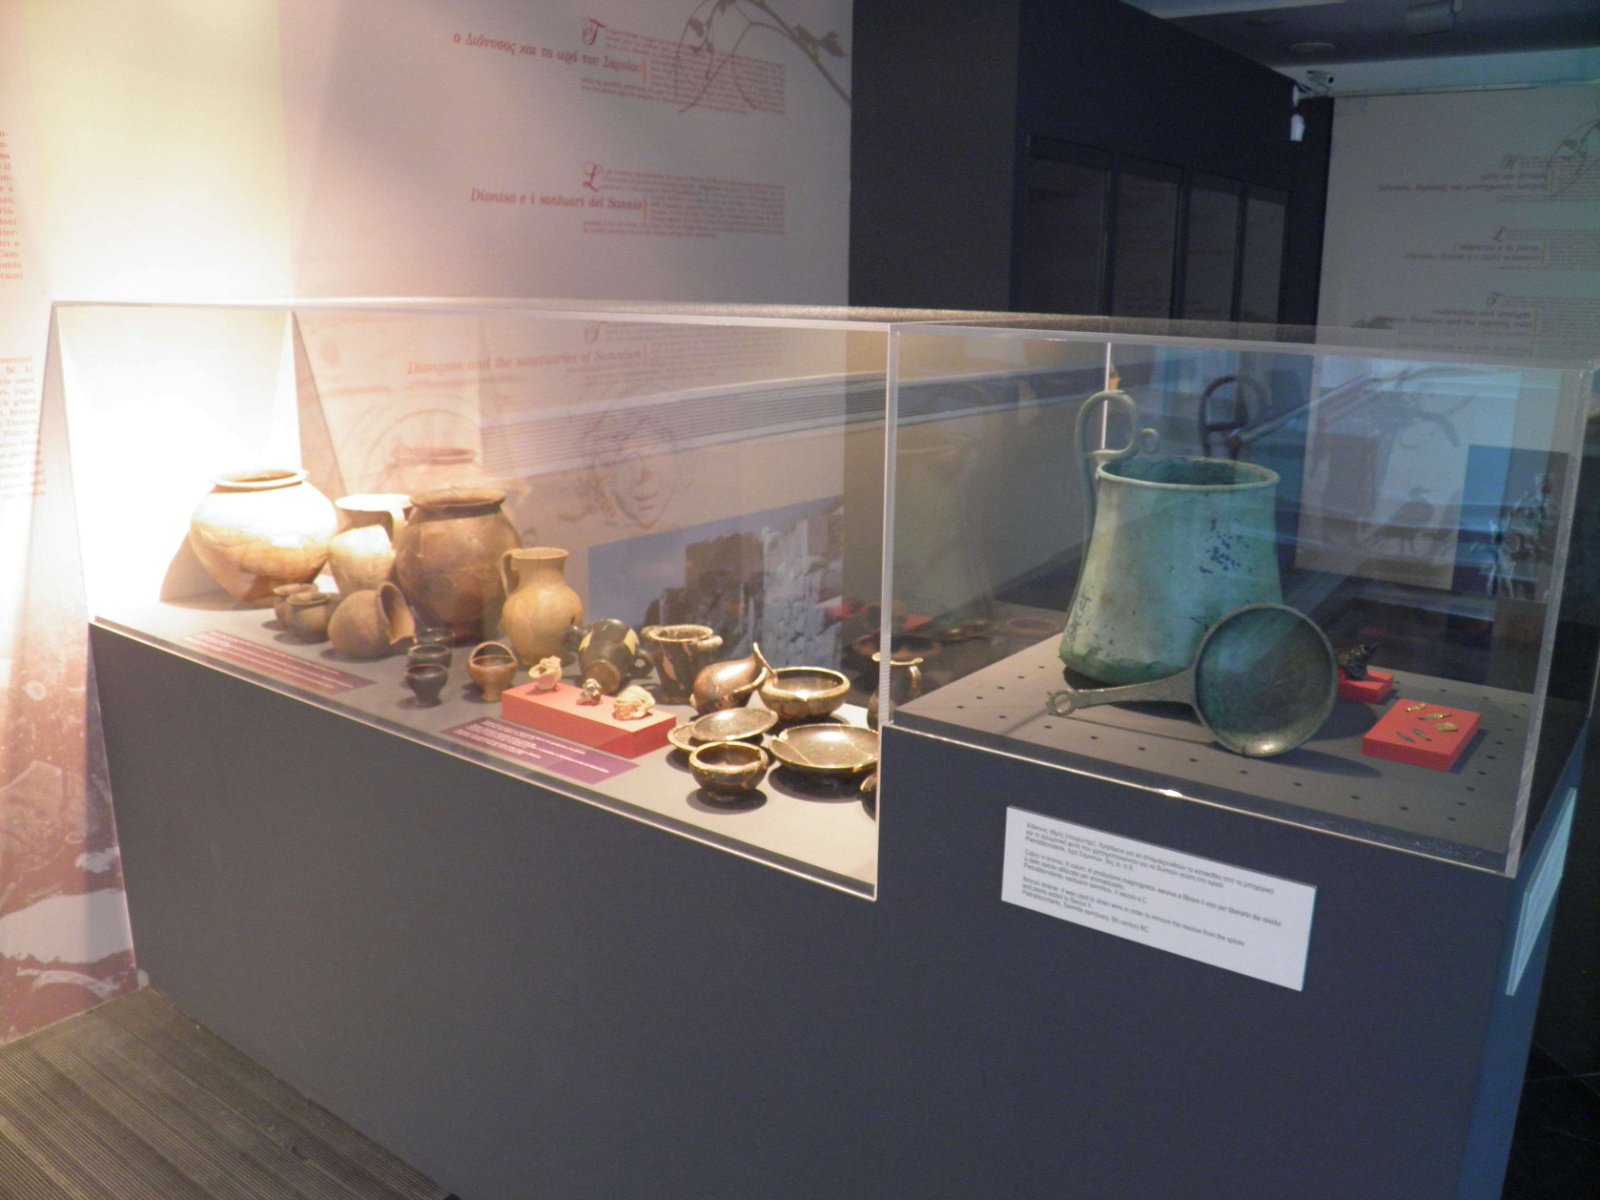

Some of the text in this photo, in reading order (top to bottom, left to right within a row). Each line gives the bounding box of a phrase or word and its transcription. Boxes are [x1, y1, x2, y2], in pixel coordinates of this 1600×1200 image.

[470, 188, 516, 203] Dioniso
[539, 193, 585, 208] santuari
[588, 195, 604, 208] del
